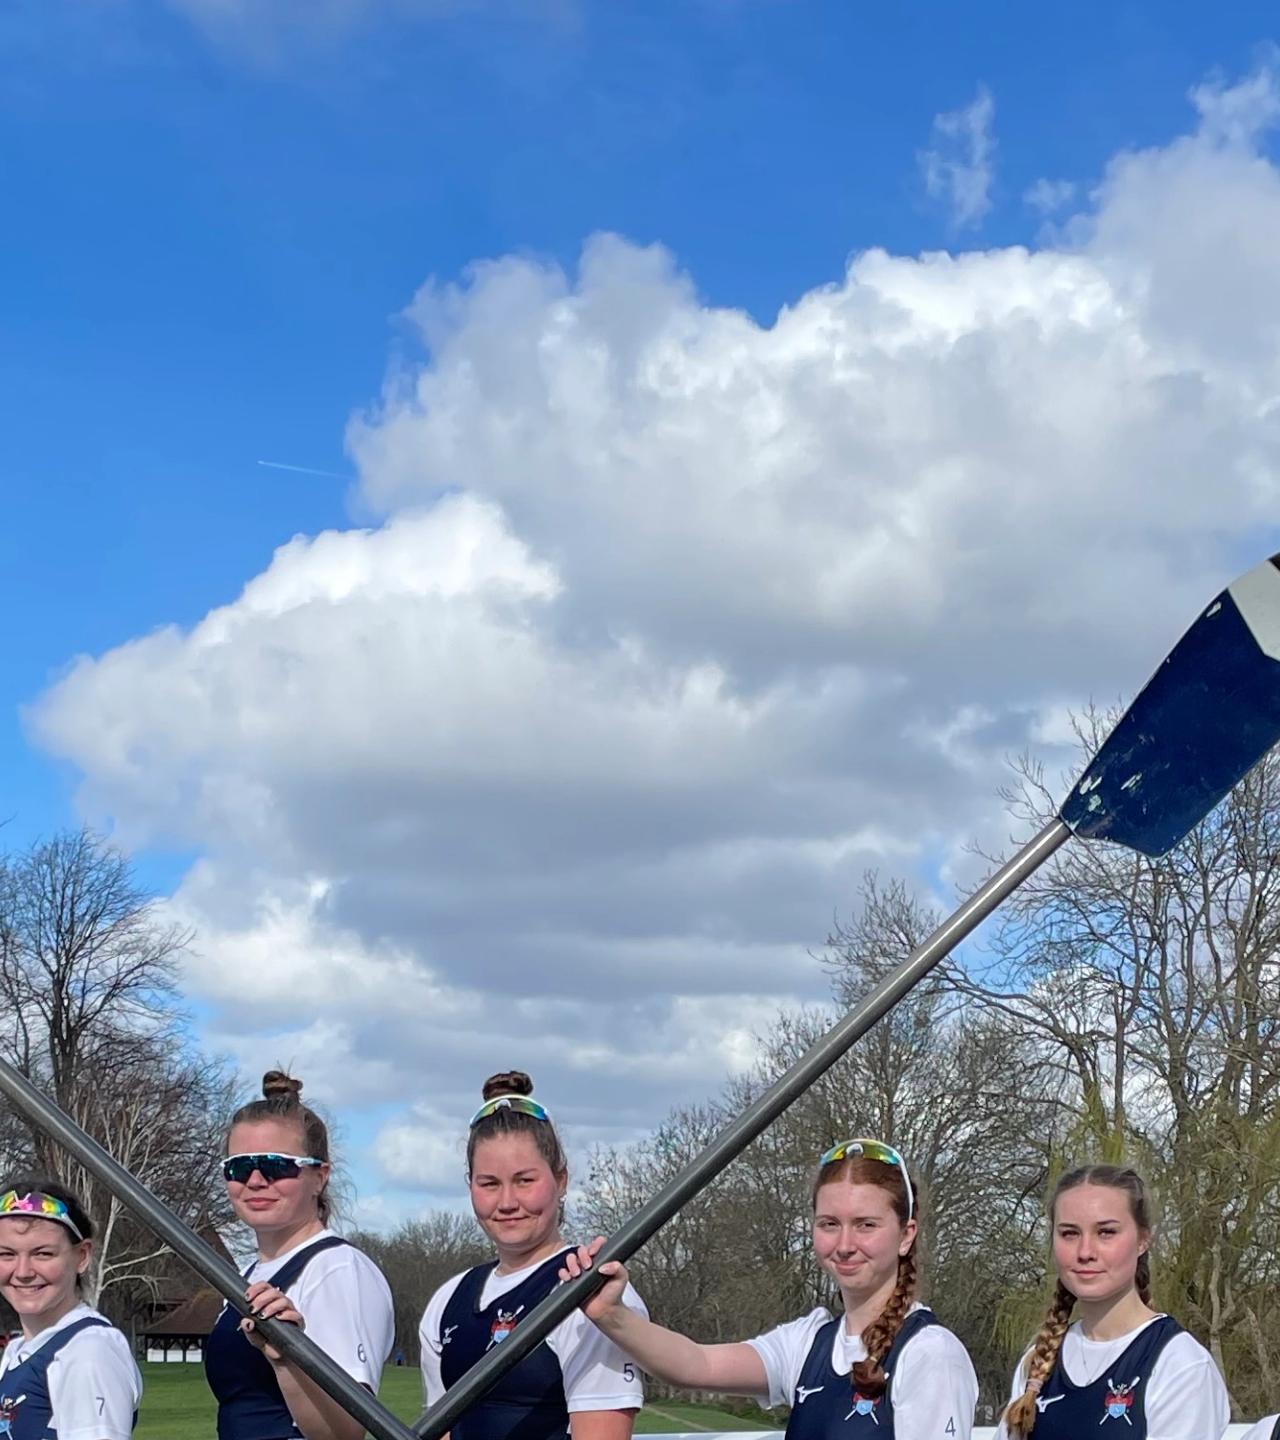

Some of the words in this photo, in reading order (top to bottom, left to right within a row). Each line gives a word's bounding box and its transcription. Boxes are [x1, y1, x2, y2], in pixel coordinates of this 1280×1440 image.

[623, 1363, 635, 1383] 5
[95, 1396, 105, 1416] 7
[945, 1416, 956, 1437] 4
